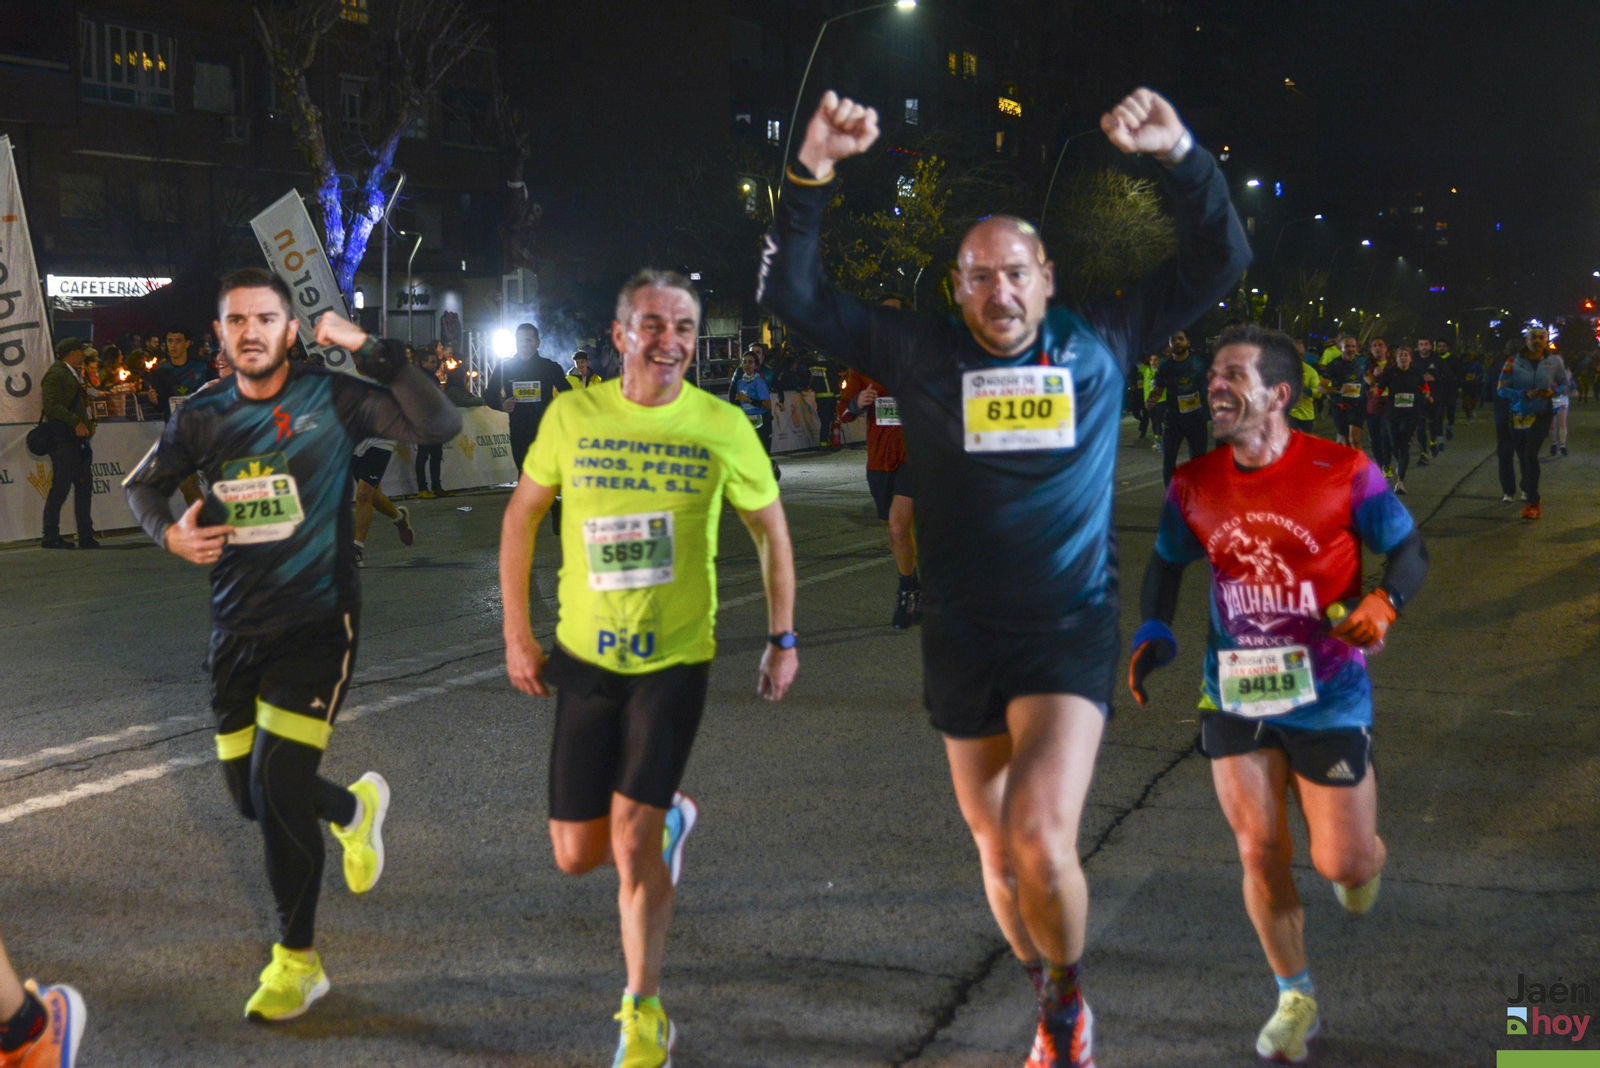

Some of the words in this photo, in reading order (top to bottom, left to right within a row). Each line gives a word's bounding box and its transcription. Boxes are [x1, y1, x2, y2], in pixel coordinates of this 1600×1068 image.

[60, 280, 142, 294] CAFETERIA
[987, 398, 1052, 421] 6100
[493, 433, 511, 445] RURA
[578, 437, 711, 461] CARPINTERÍA
[643, 460, 709, 480] PÉREZ
[92, 478, 111, 494] AÉN
[234, 500, 284, 520] 2781
[602, 540, 658, 564] 5697
[1219, 581, 1321, 620] VALHALLA
[1229, 667, 1246, 676] SAN
[1239, 673, 1296, 694] 9419
